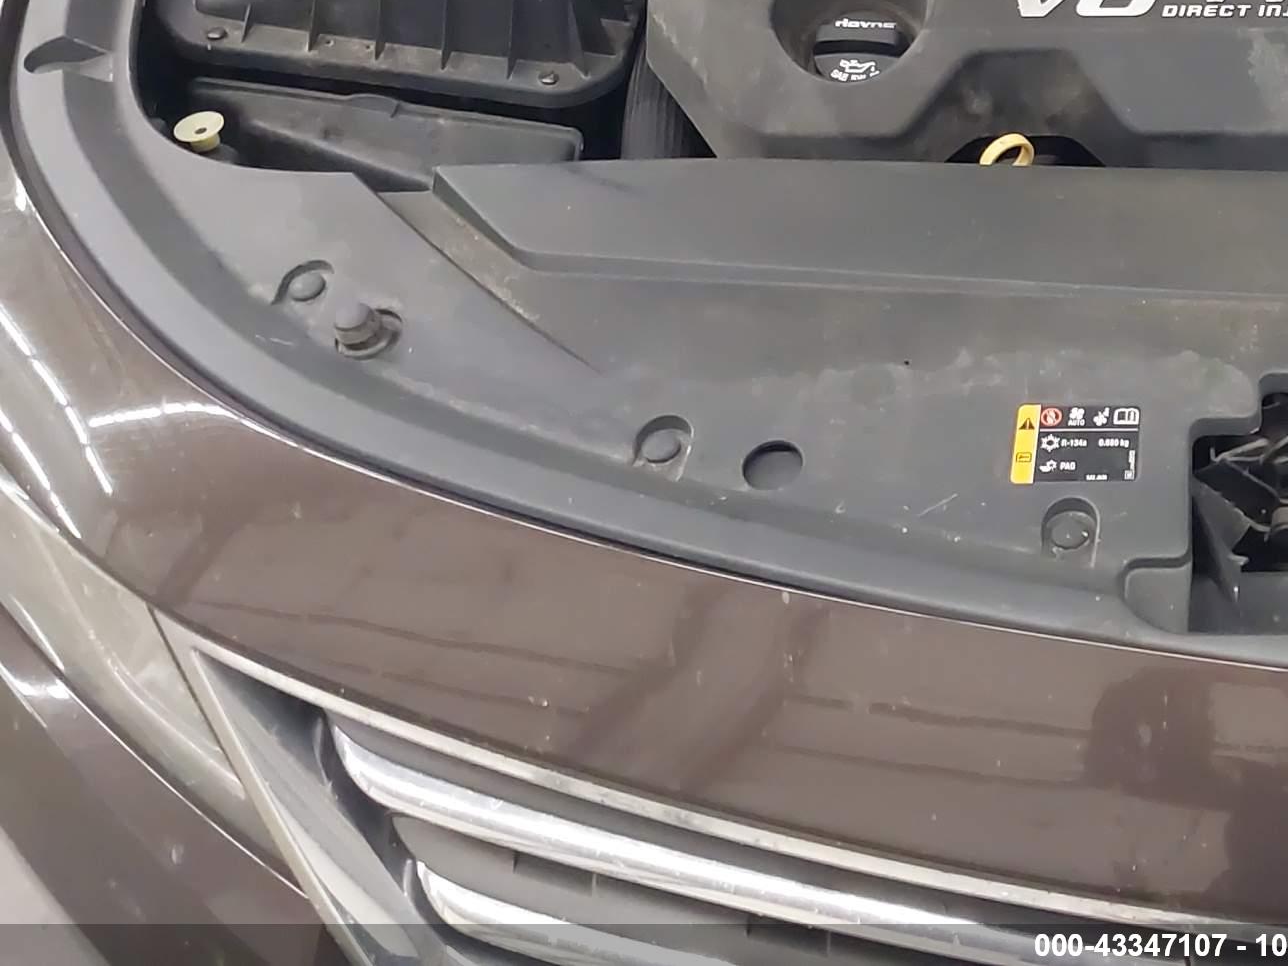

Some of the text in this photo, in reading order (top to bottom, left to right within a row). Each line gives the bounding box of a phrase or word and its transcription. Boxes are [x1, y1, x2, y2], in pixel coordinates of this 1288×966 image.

[1161, 4, 1252, 18] DIRECT
[1067, 418, 1086, 427] AUTO
[1120, 438, 1130, 448] kg
